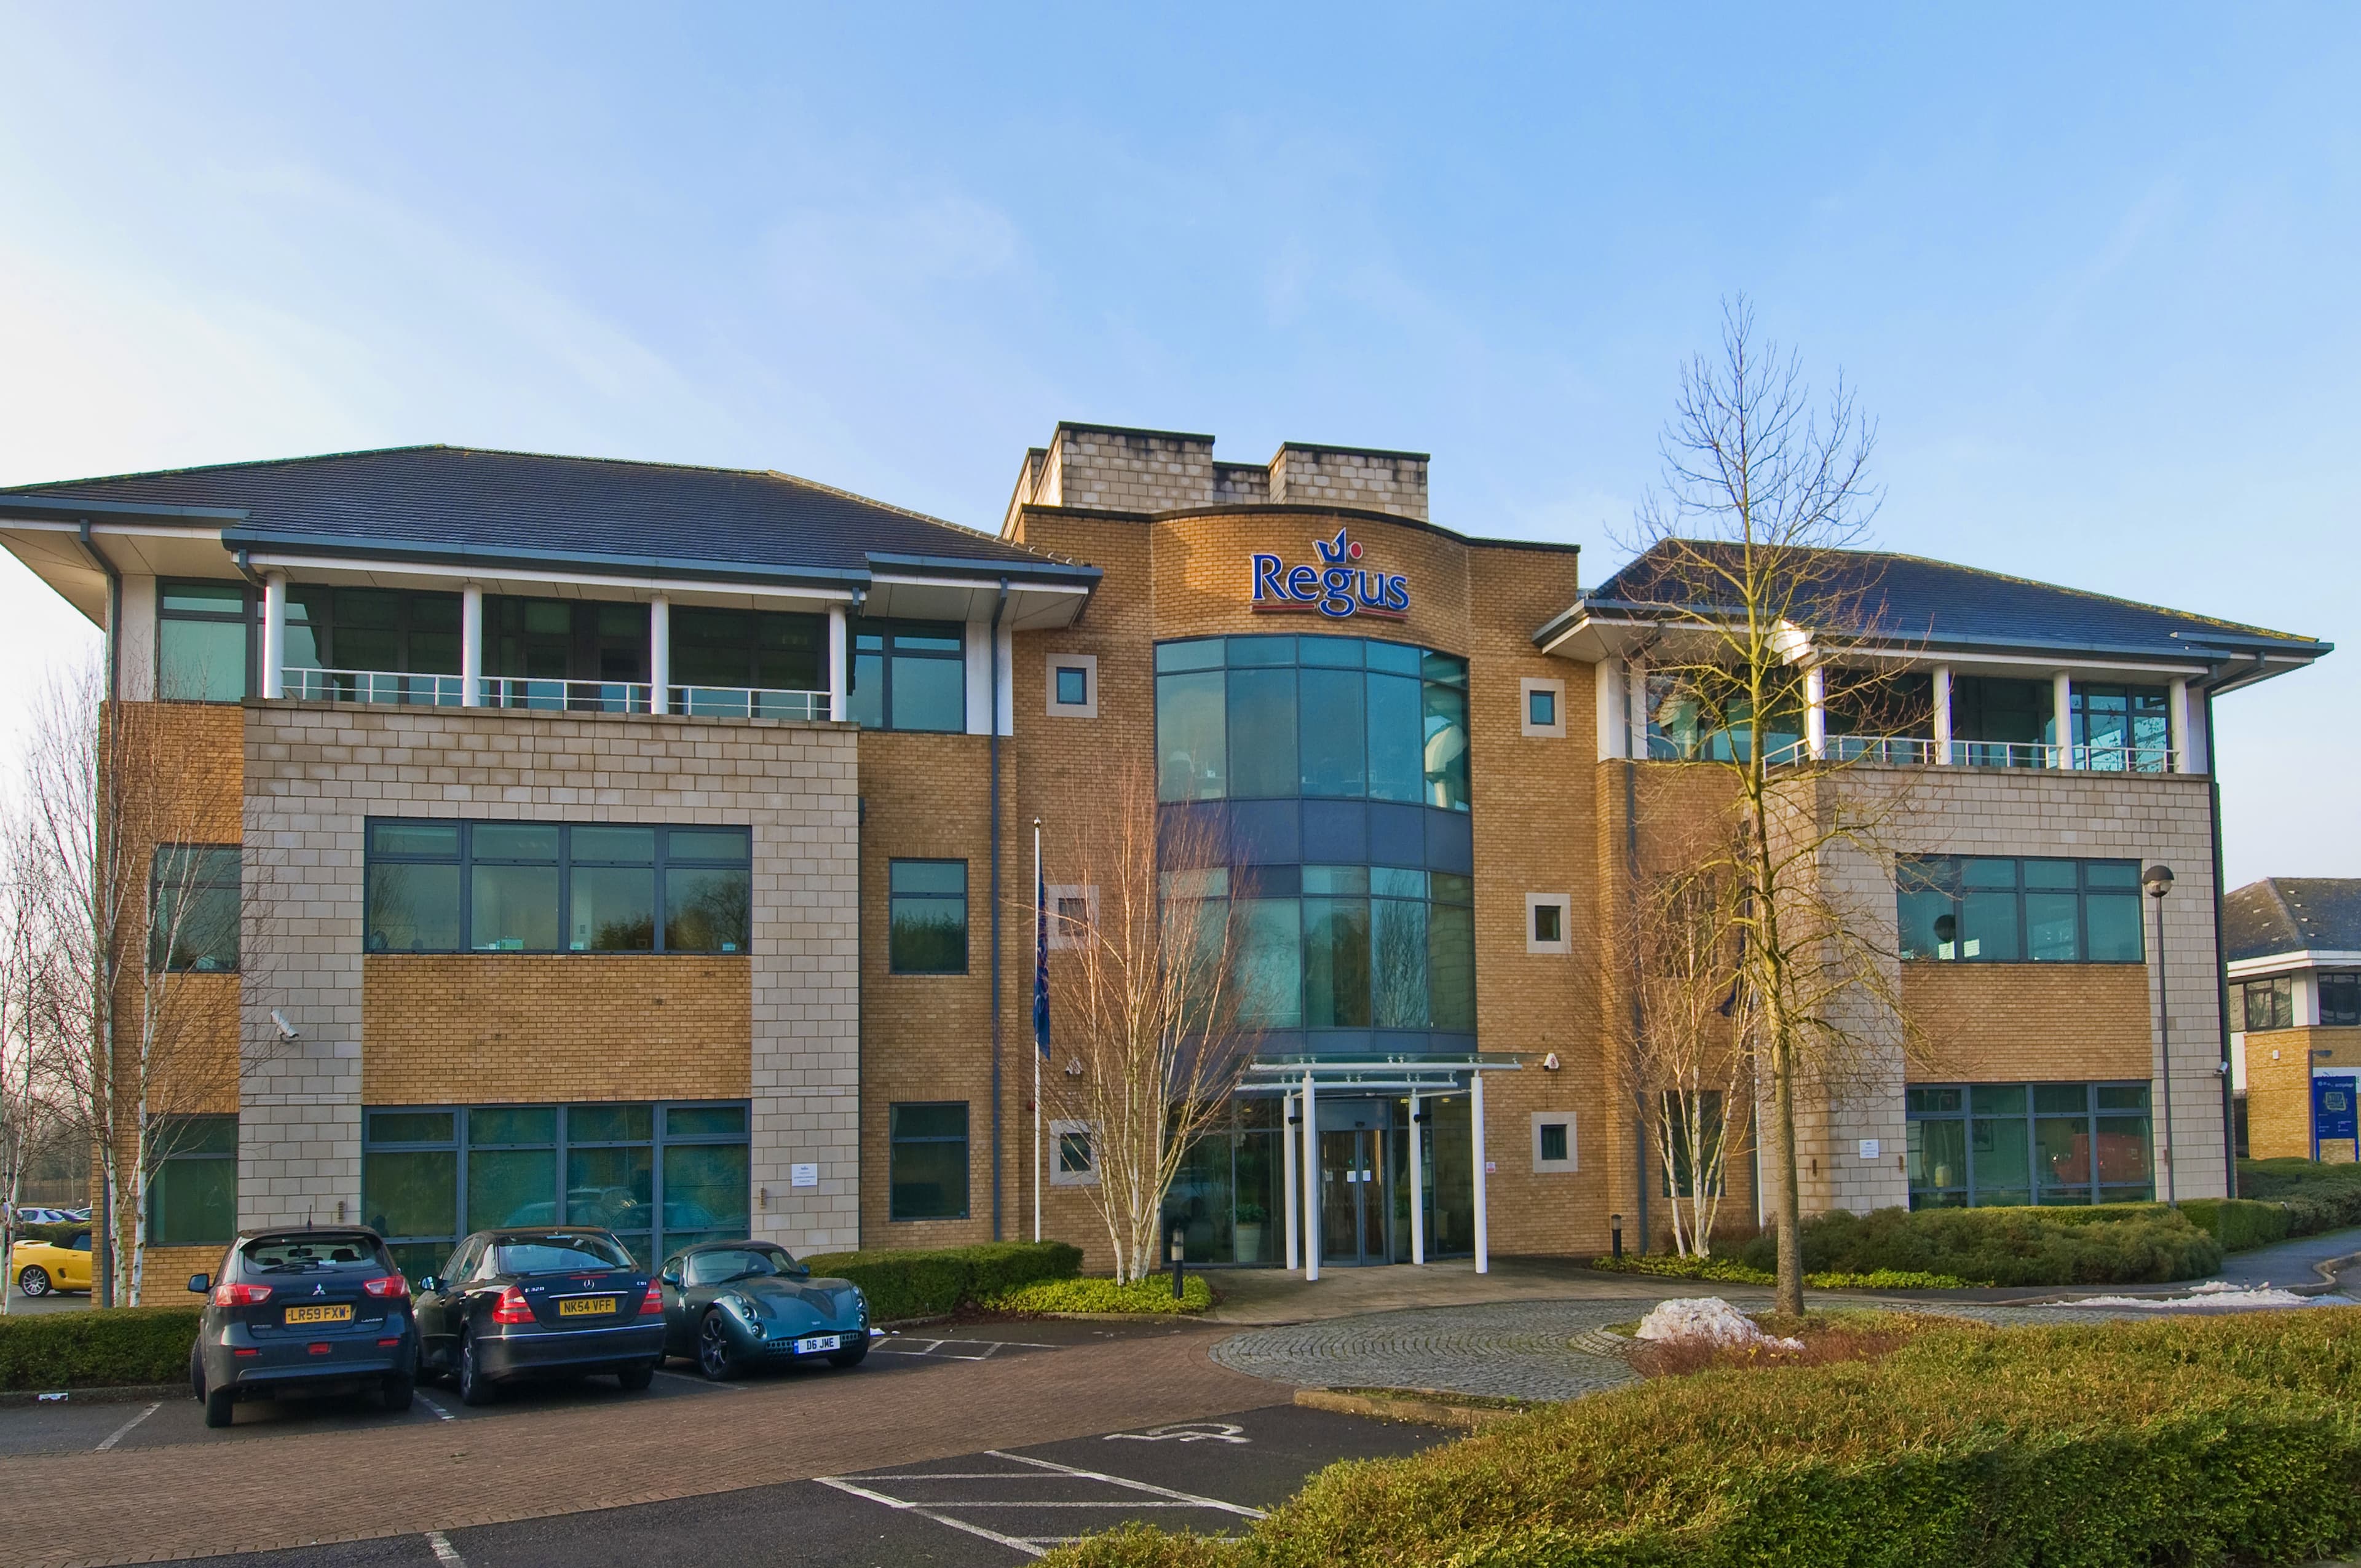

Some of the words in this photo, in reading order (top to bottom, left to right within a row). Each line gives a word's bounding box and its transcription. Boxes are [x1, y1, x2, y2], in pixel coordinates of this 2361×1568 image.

[1251, 553, 1410, 617] Regus
[564, 1301, 590, 1313] NK54
[593, 1299, 611, 1311] VFF
[291, 1308, 321, 1321] LR59
[324, 1307, 346, 1318] FXW
[807, 1340, 817, 1350] D6
[820, 1338, 834, 1348] JME
